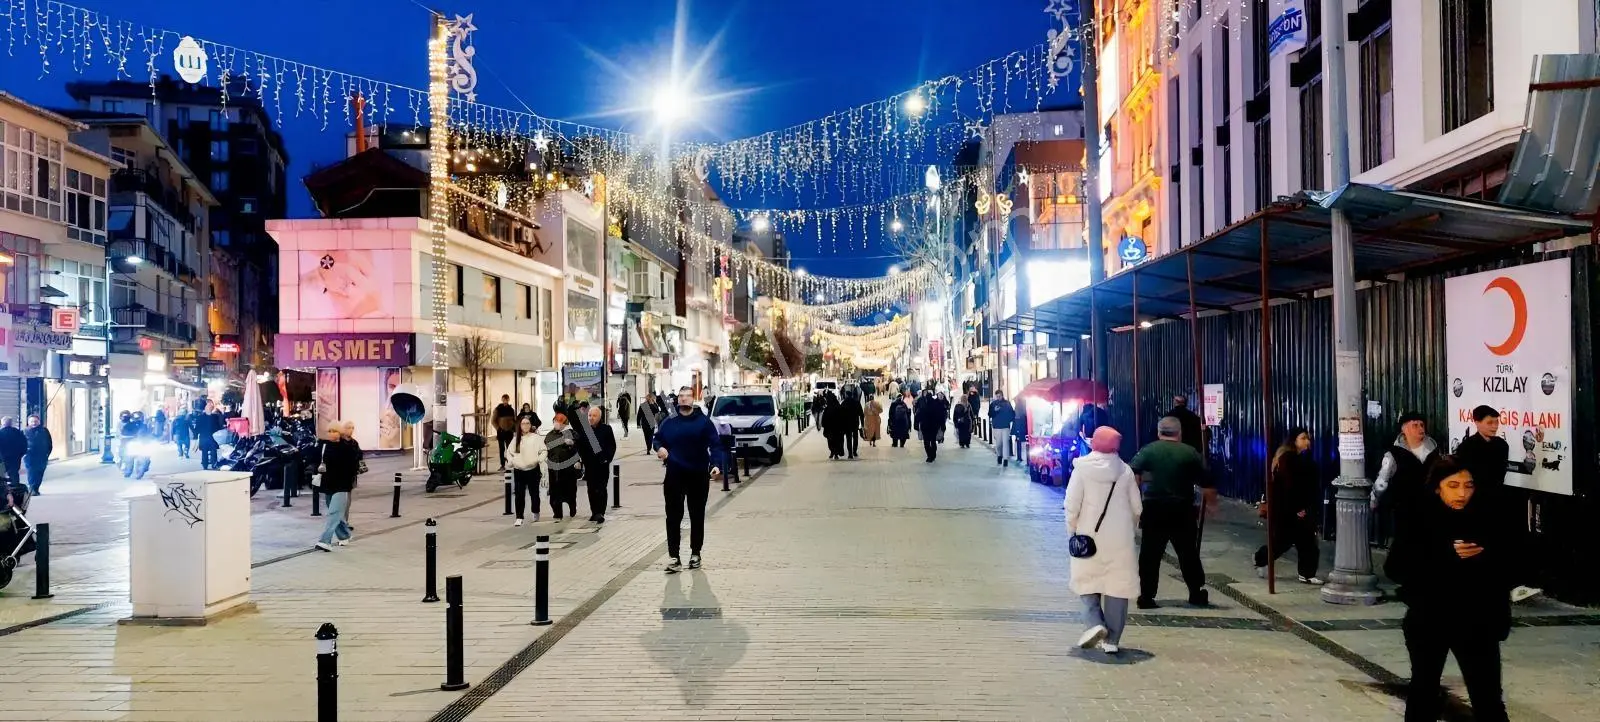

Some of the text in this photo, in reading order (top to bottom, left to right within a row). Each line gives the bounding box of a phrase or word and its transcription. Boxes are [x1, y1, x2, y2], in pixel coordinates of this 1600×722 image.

[293, 339, 395, 362] HAŞMET
[1496, 363, 1514, 374] TÜRK
[1483, 376, 1528, 393] KIZILAY
[1522, 411, 1561, 429] ALANI
